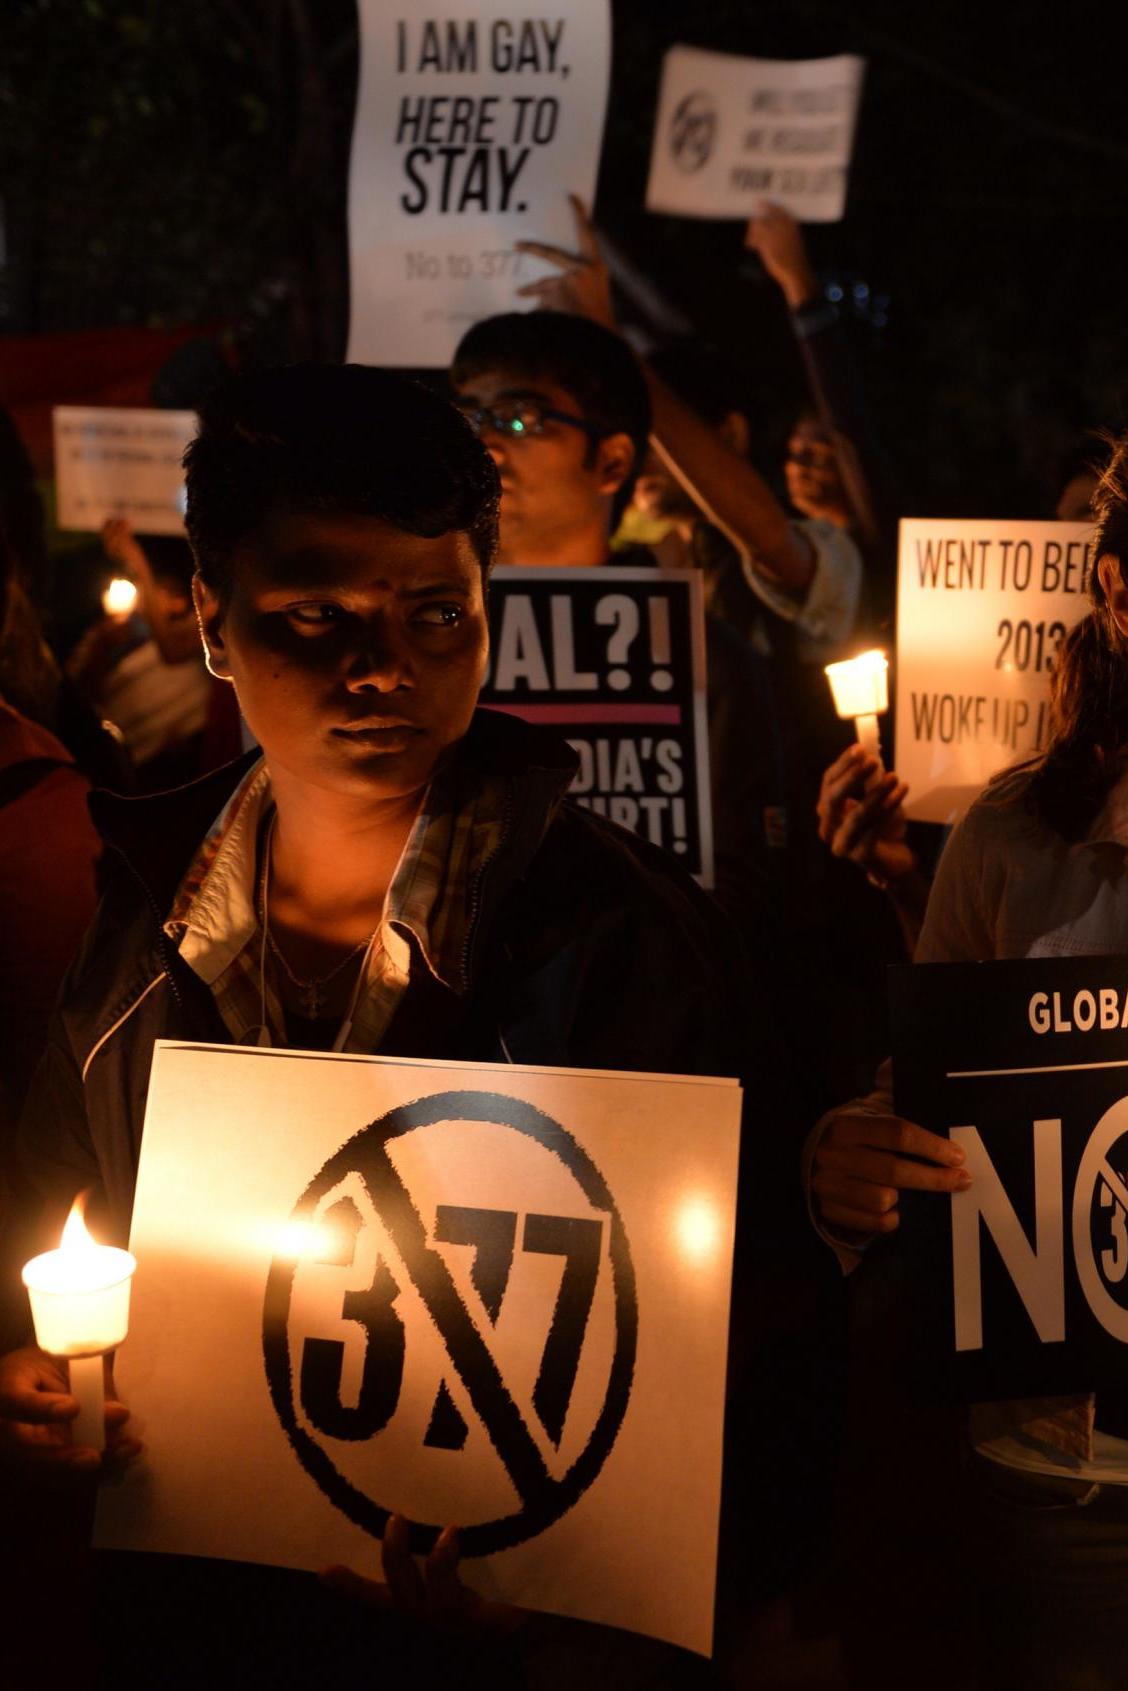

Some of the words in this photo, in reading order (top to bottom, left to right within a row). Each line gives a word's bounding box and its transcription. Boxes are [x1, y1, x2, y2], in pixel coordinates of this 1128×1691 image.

[397, 20, 406, 73] I
[418, 20, 477, 73] AM
[491, 19, 570, 78] GAY,
[397, 97, 500, 145] HERE
[511, 97, 559, 145] TO
[402, 148, 530, 214] STAY.
[404, 251, 439, 280] No
[916, 540, 991, 590] WENT
[999, 540, 1033, 592] TO
[1041, 542, 1089, 594] BE
[911, 693, 987, 743] WOKE
[302, 1197, 604, 1454] 377
